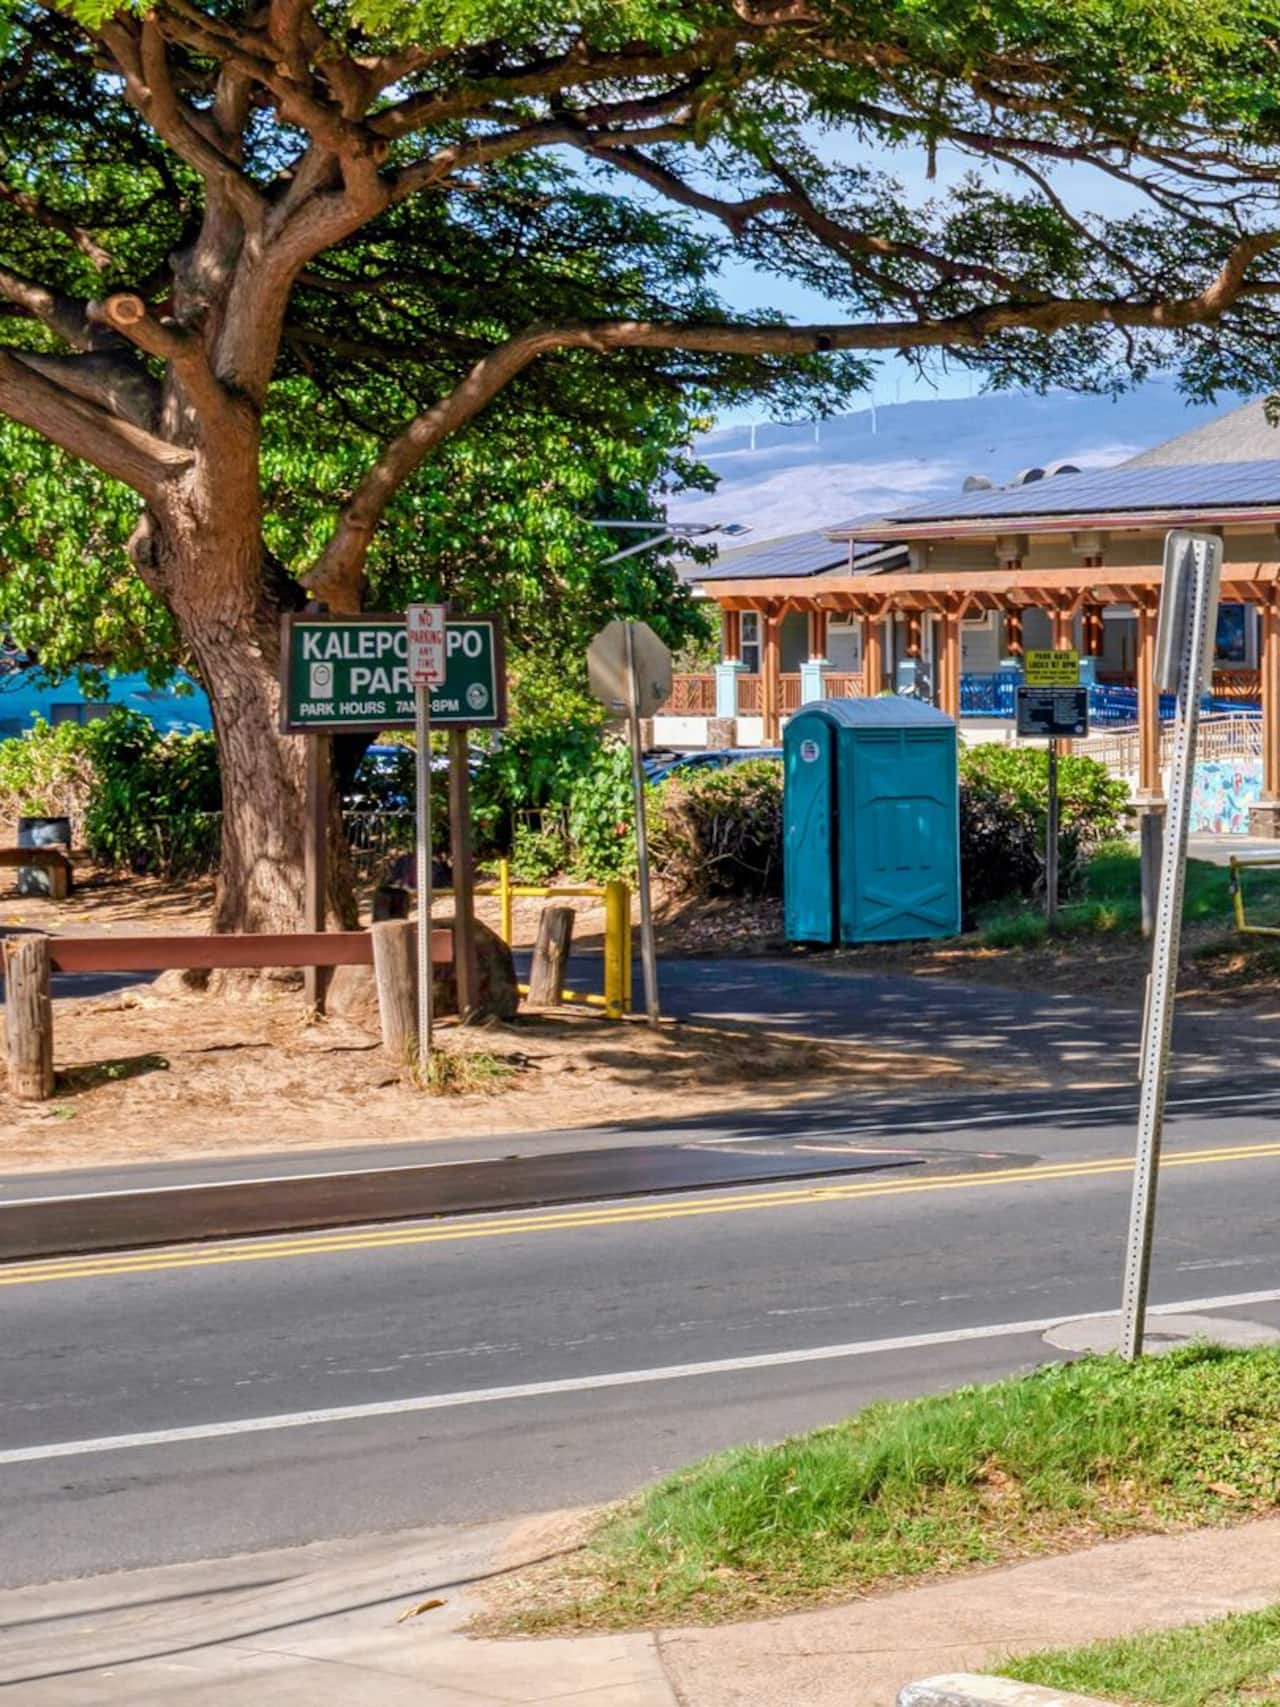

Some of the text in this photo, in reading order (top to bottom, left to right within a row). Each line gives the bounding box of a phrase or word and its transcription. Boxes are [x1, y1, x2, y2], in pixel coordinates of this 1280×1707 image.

[418, 613, 433, 627] NO
[303, 630, 483, 660] KALEPOPO
[300, 702, 335, 716] PARK
[339, 701, 386, 715] HOURS
